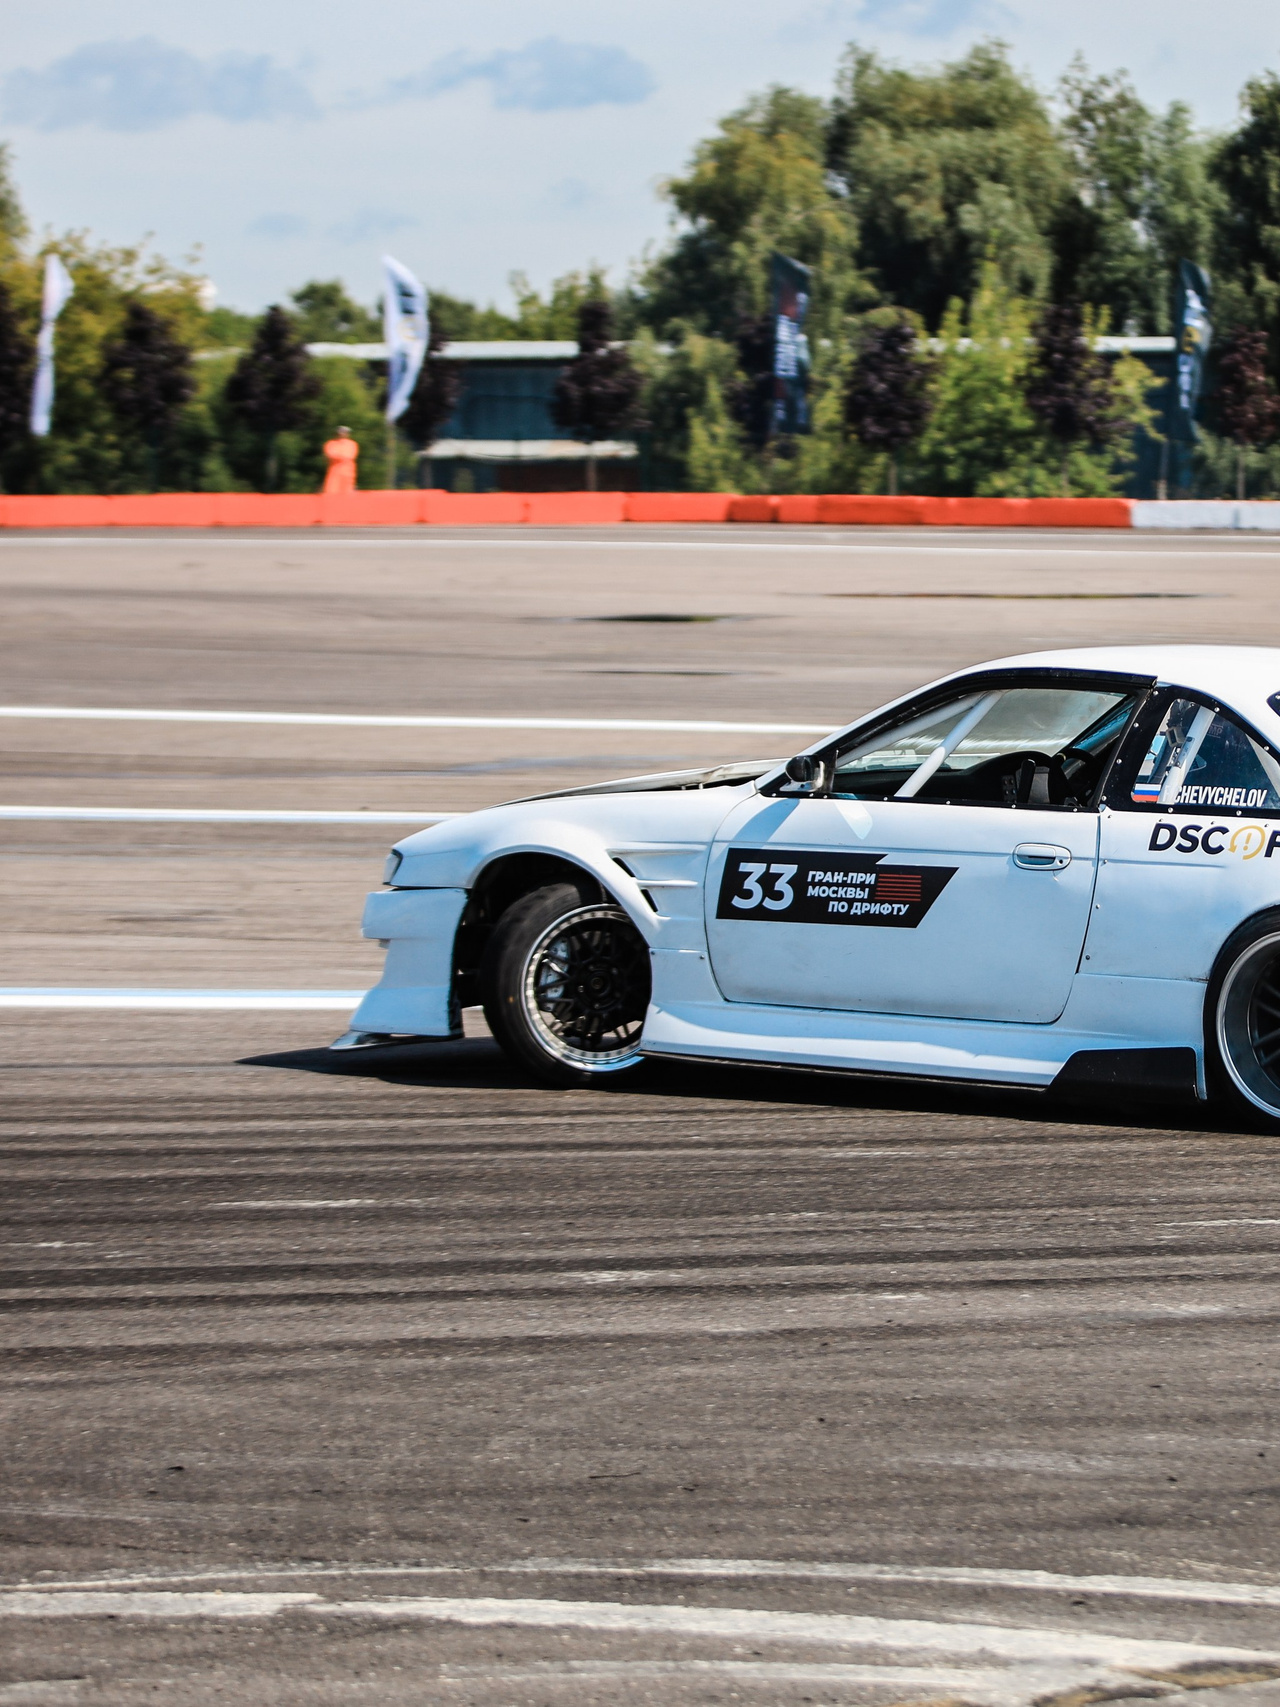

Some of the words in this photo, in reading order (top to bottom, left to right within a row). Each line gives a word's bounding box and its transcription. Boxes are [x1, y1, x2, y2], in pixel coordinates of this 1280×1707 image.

[1174, 785, 1268, 808] CHEVYCHELOV
[807, 870, 876, 885] ГРАН-ПРИ
[731, 862, 799, 911] 33
[807, 885, 869, 899] МОСКВЫ
[828, 901, 848, 913] ПО
[850, 903, 910, 916] ДРИФТУ
